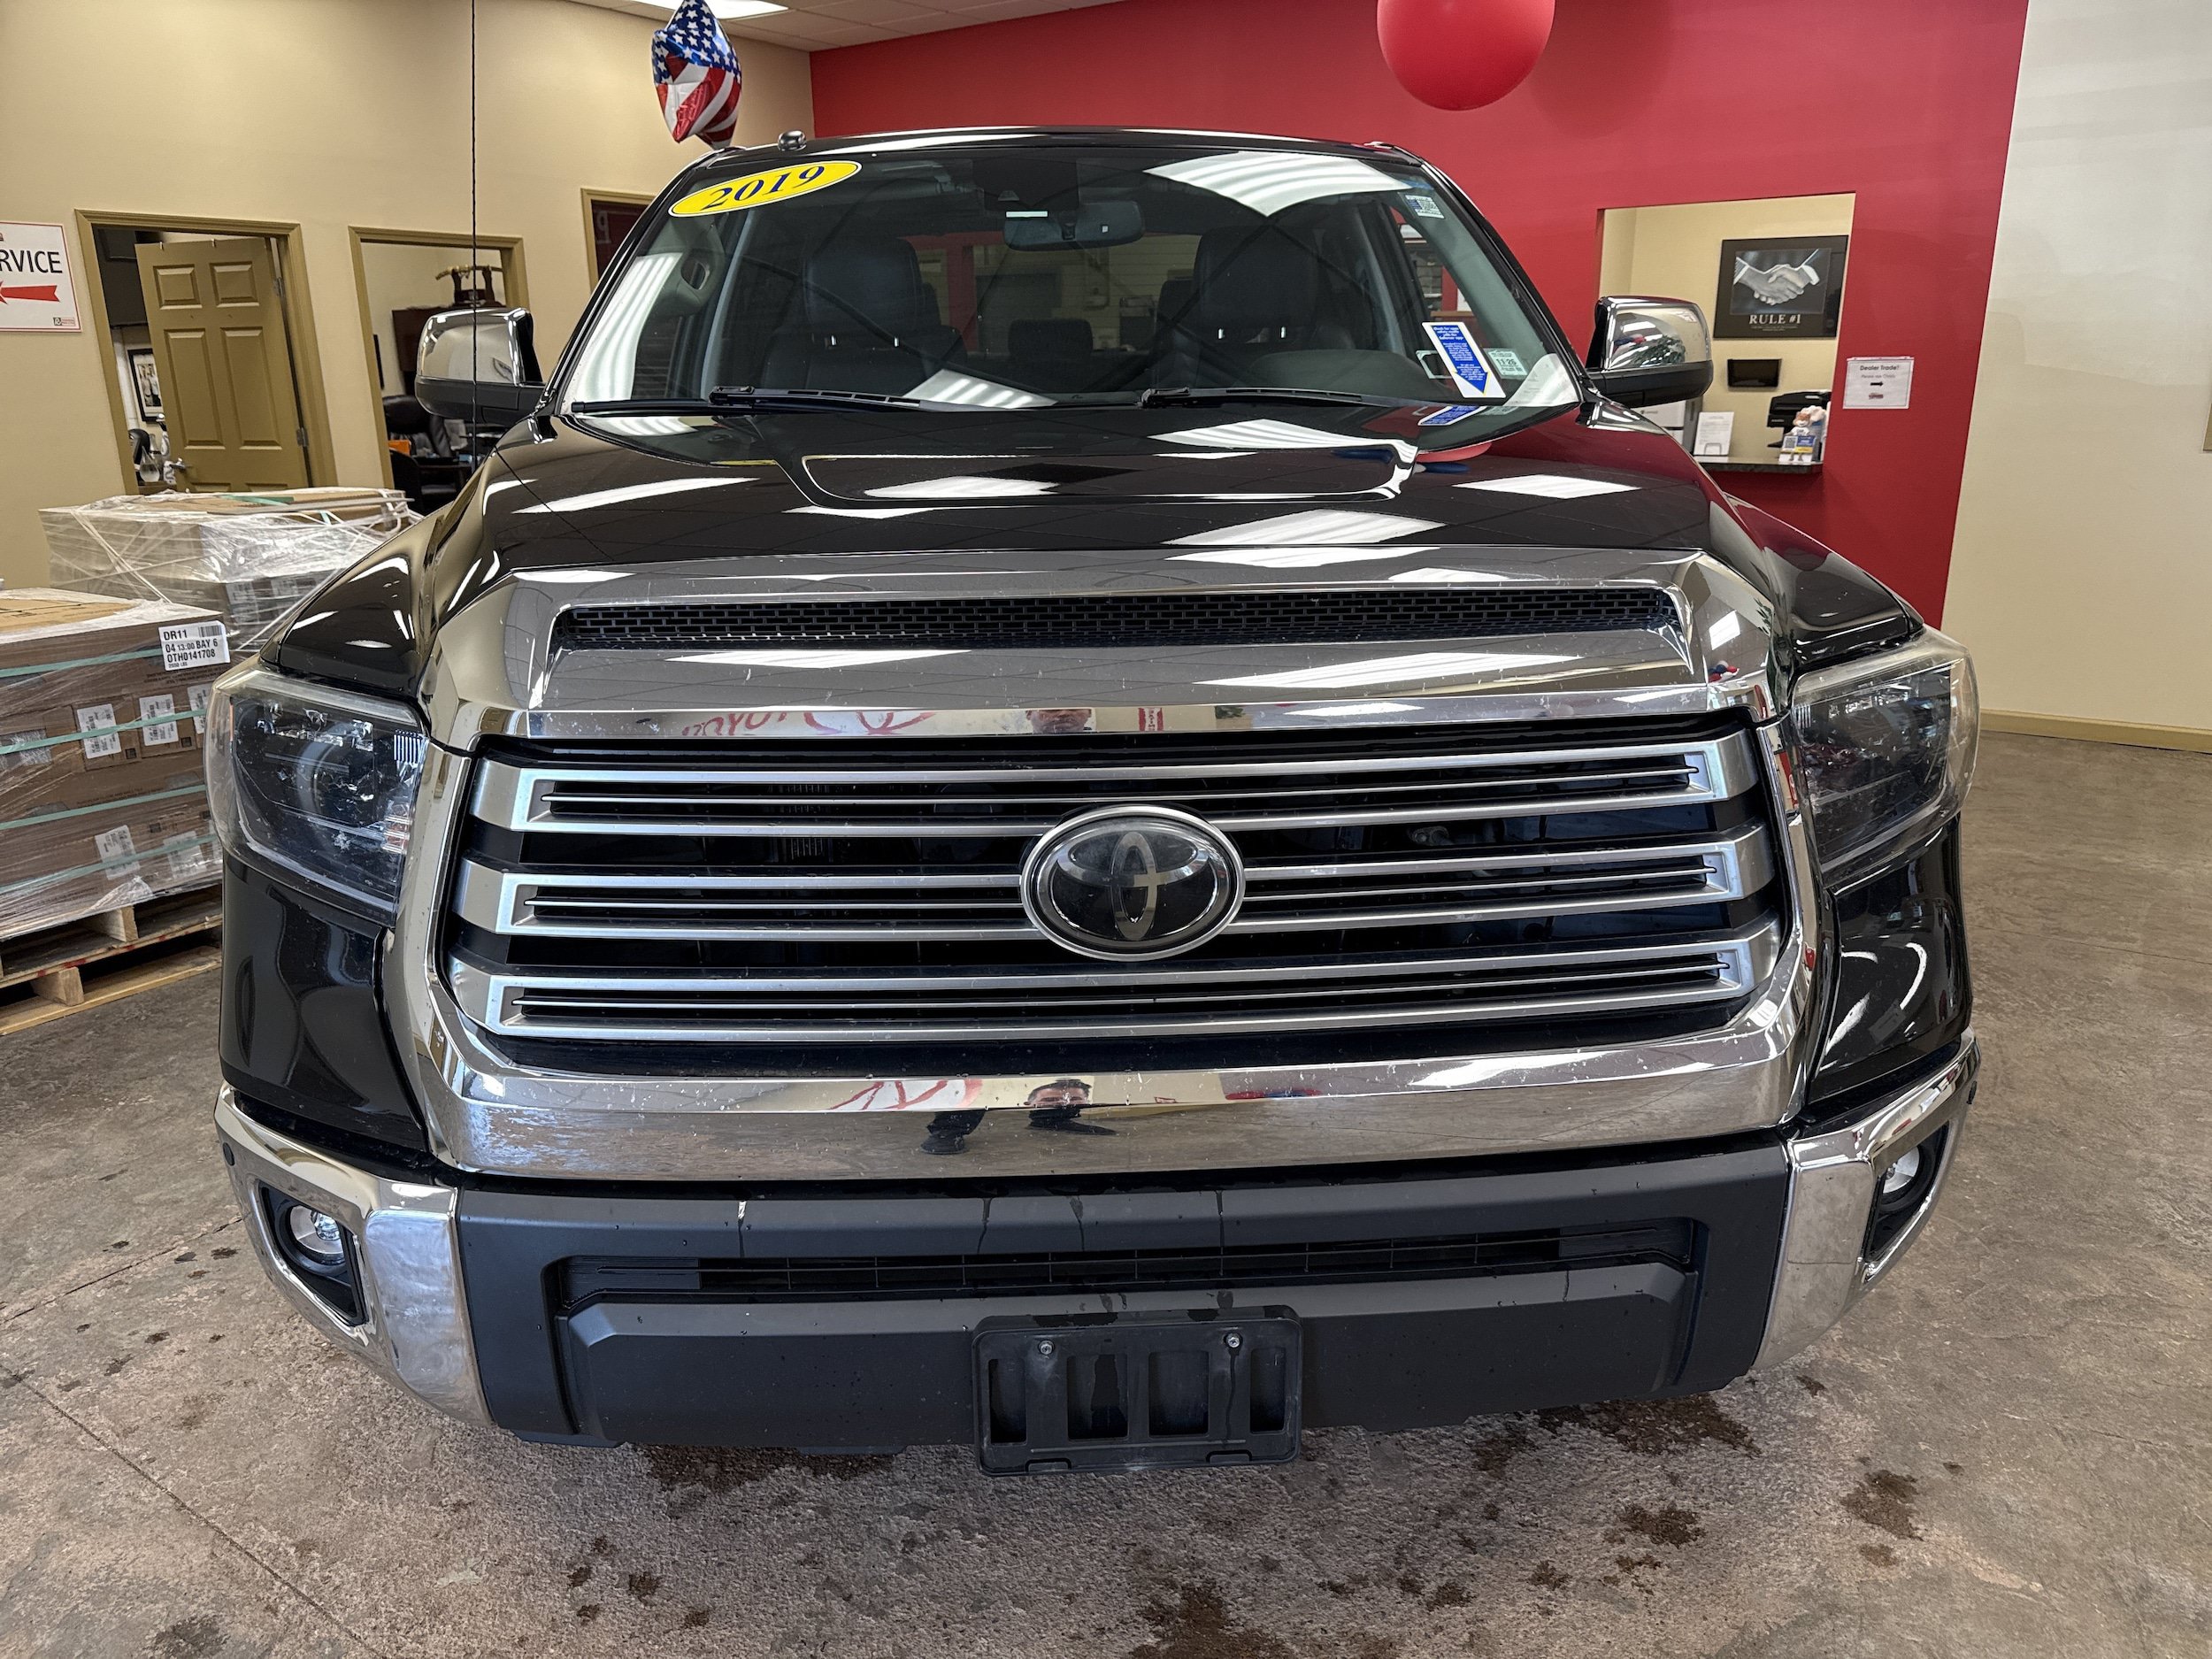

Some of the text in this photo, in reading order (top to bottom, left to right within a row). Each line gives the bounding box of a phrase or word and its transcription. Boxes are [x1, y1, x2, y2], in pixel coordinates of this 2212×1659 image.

[701, 165, 826, 211] 2019
[1748, 313, 1801, 325] RULE #1
[164, 630, 188, 641] DR11
[165, 644, 176, 653] 04
[177, 642, 195, 651] 13:00
[196, 640, 211, 649] BAY
